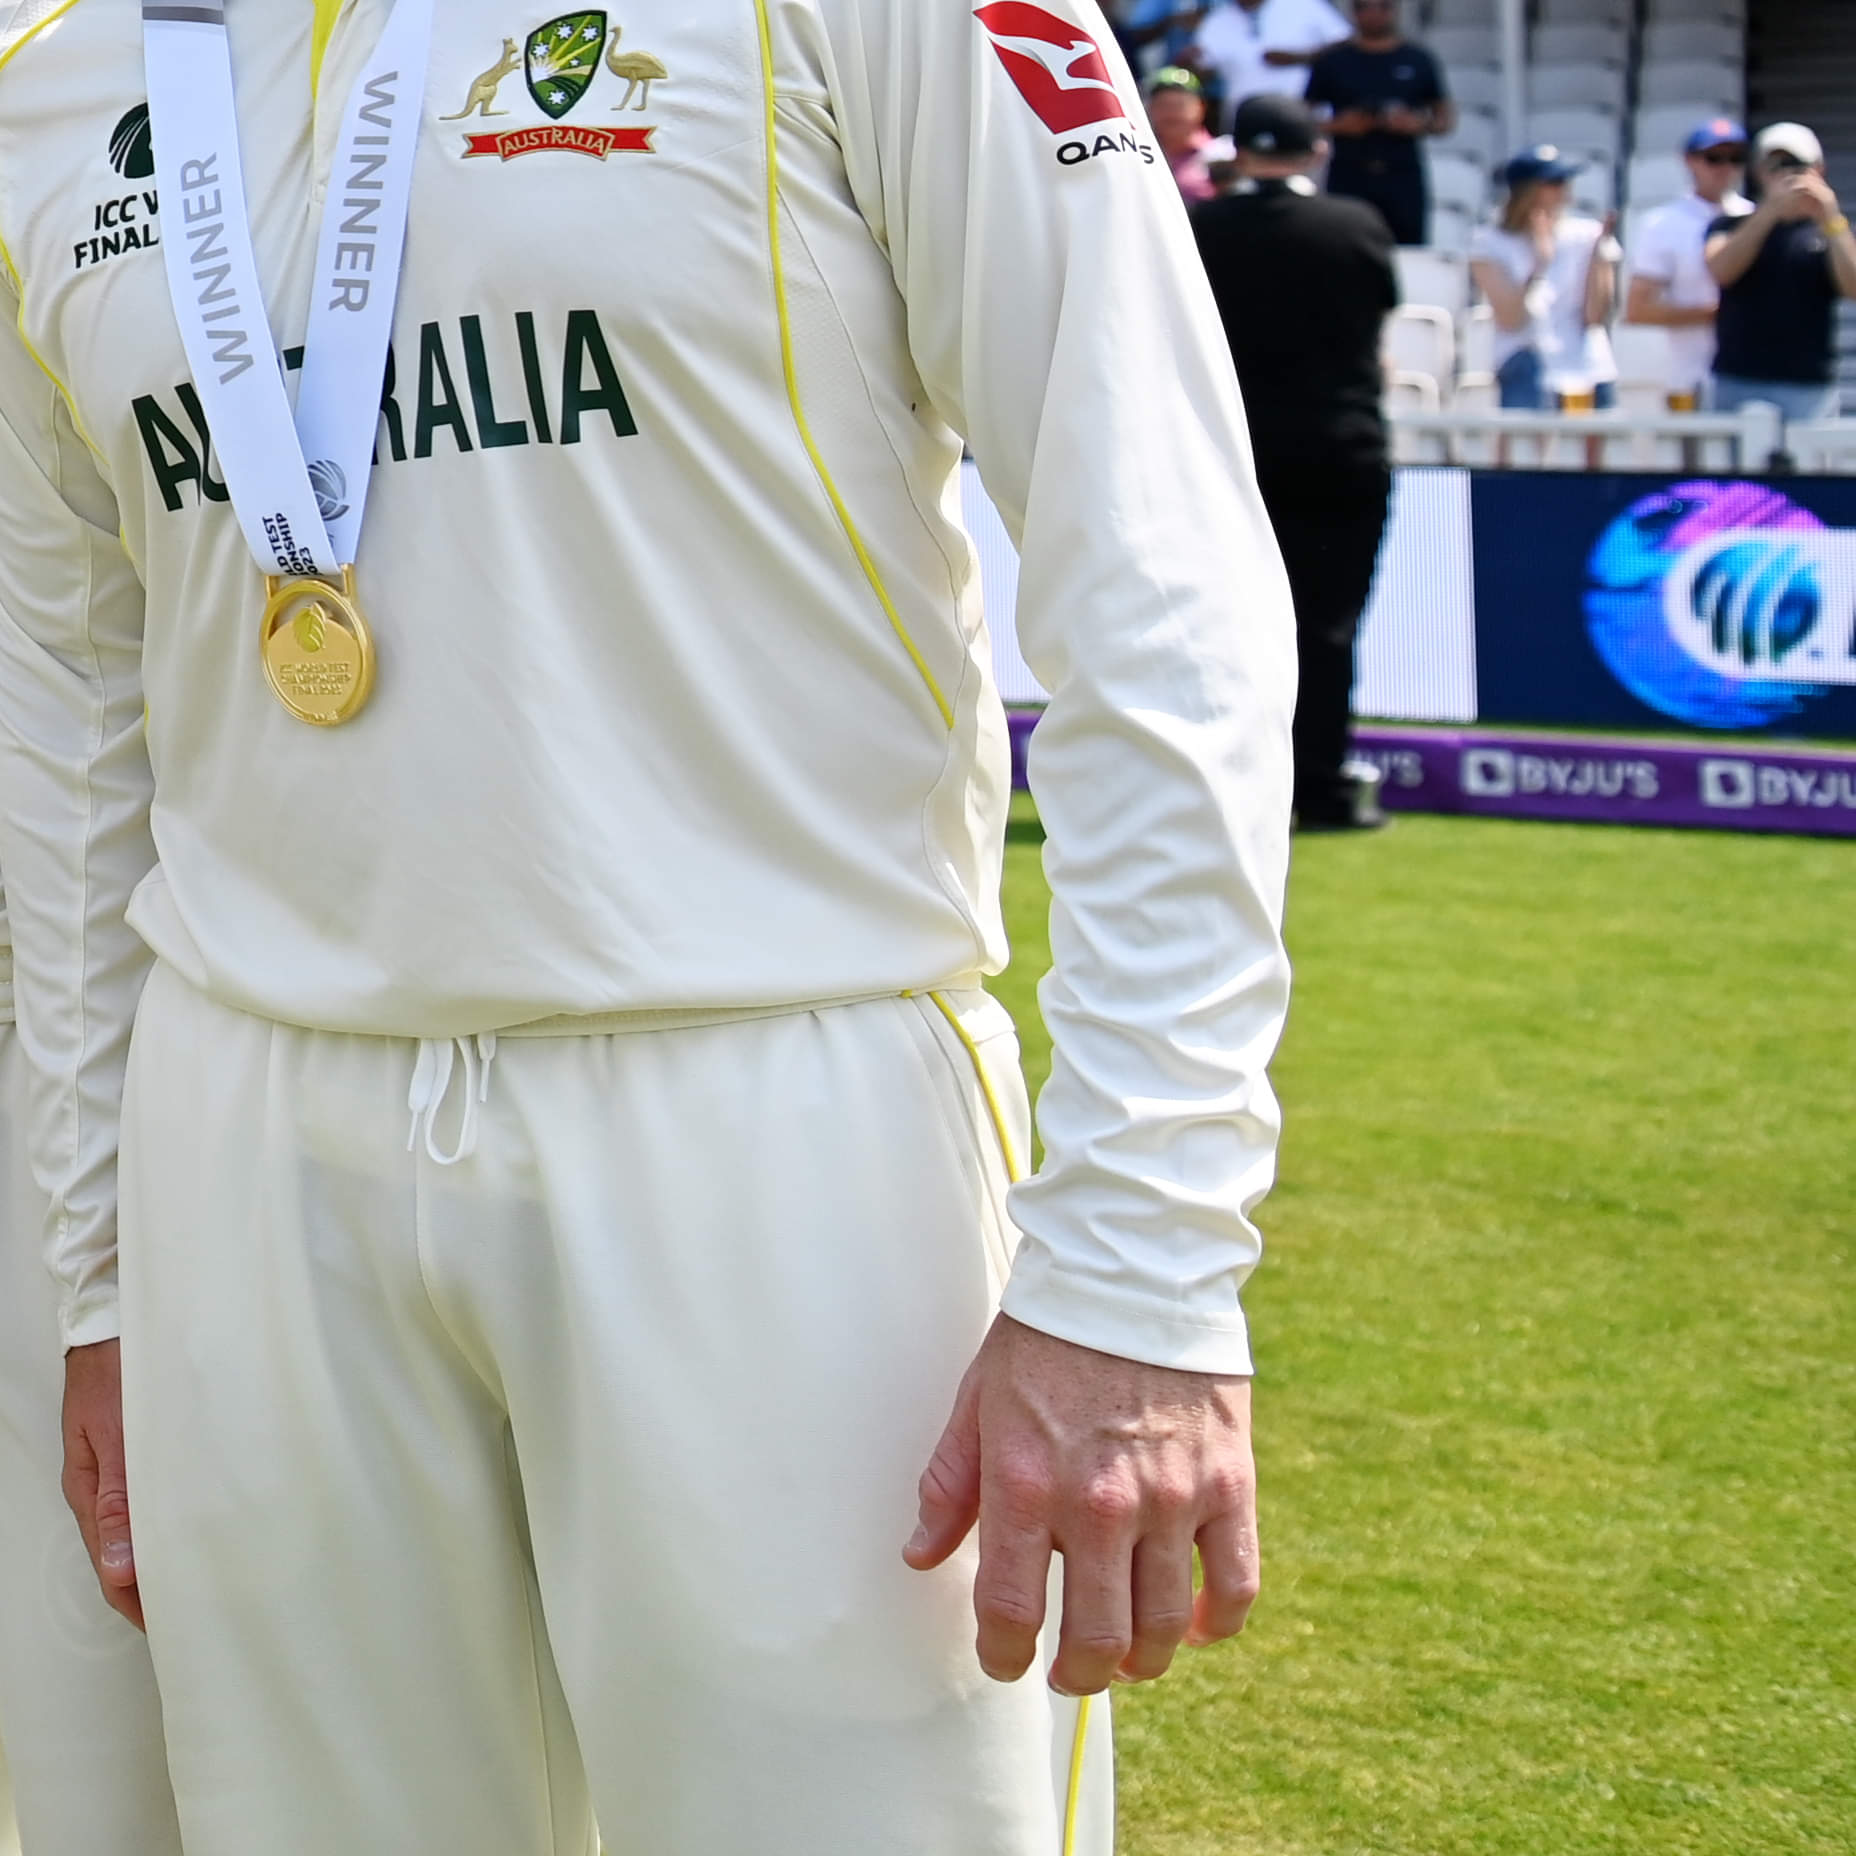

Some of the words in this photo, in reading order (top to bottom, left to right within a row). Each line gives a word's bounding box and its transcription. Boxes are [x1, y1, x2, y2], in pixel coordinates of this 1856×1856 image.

[504, 127, 606, 155] AUSTRALIA
[95, 195, 137, 231] ICC
[329, 71, 398, 312] WINNER
[74, 224, 160, 269] FINAL
[180, 152, 254, 384] WINNER
[262, 516, 282, 554] TEST
[275, 513, 309, 575] IONSHIP
[299, 547, 324, 576] 023
[1518, 754, 1660, 800] BYJU'S
